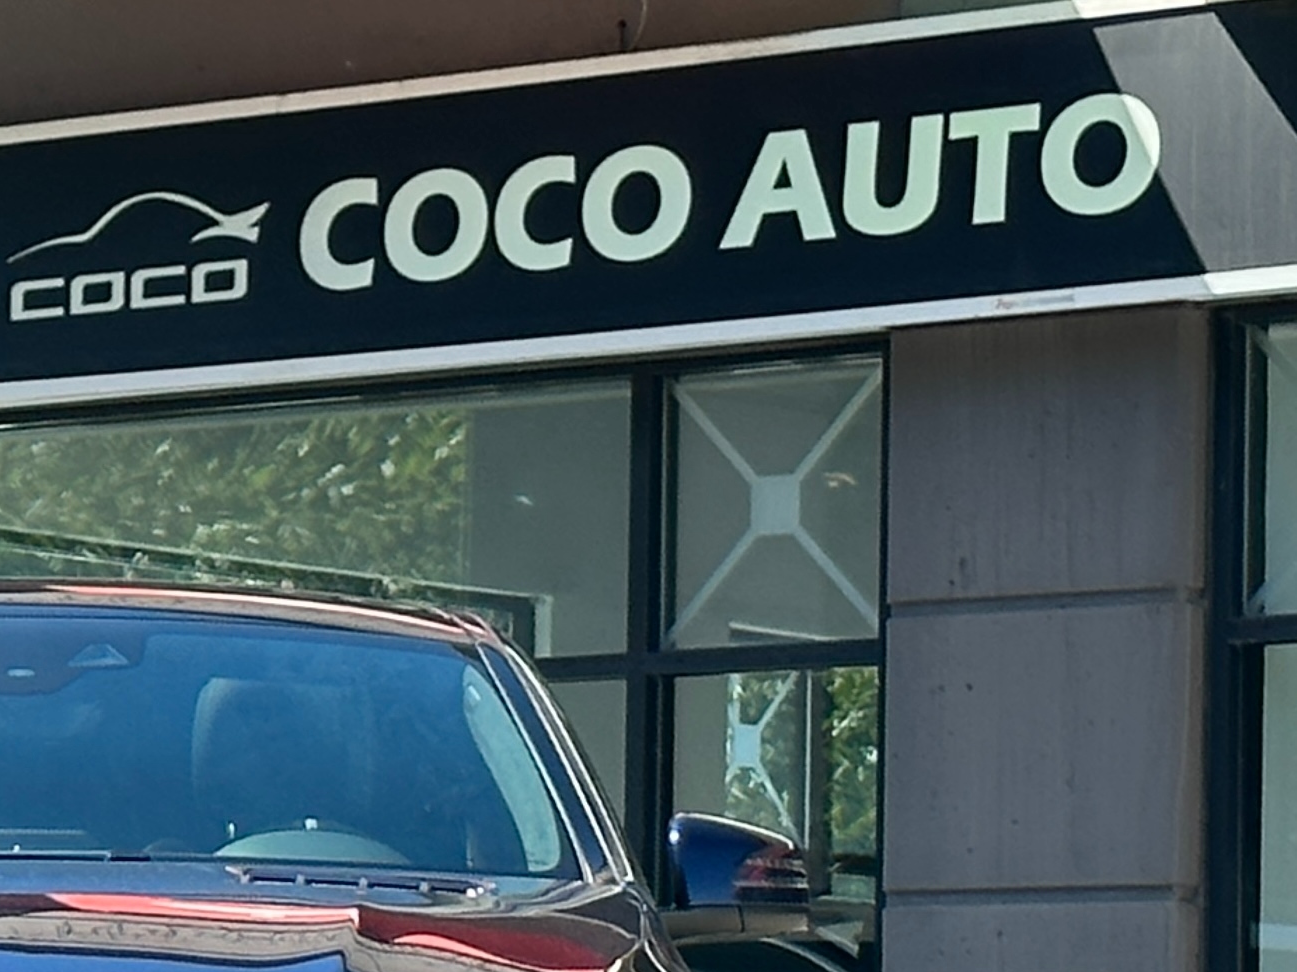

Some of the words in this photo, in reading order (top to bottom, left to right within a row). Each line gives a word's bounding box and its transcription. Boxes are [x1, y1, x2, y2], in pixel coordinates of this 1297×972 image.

[299, 145, 692, 291] COCO
[719, 92, 1161, 250] AUTO
[9, 258, 248, 322] COCO
